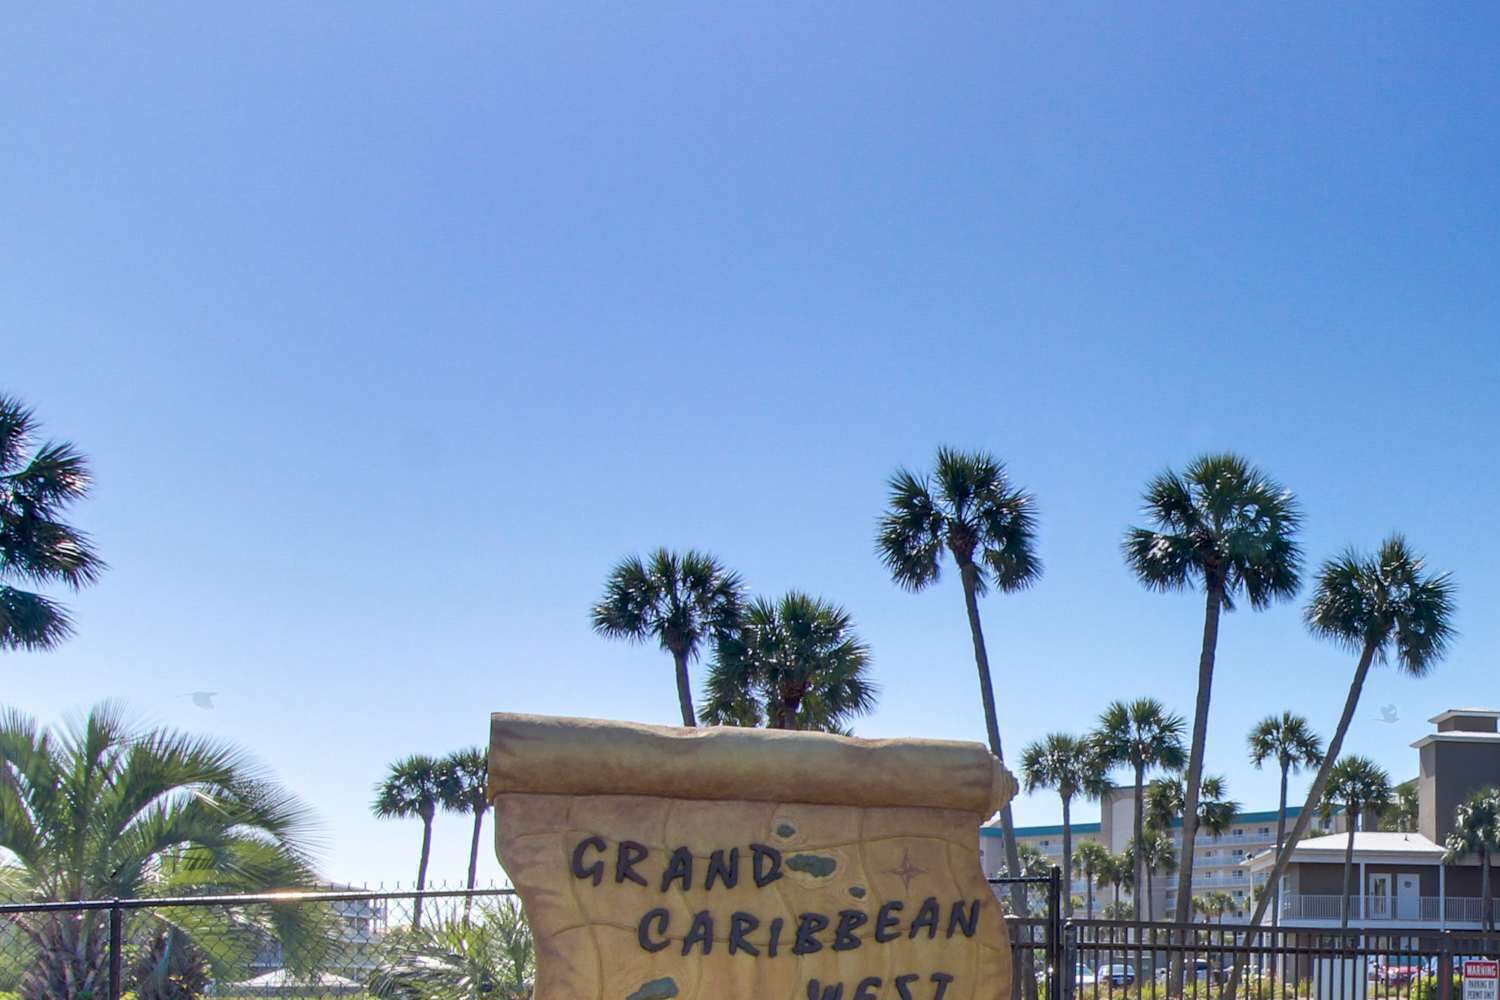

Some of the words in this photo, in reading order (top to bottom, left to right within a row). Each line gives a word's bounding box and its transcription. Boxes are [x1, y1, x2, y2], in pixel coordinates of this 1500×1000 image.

[572, 836, 784, 893] GRAND
[637, 898, 981, 957] CARIBBEAN
[1466, 964, 1496, 977] WARNING
[1468, 980, 1487, 989] PARKING
[1467, 991, 1482, 1000] PERMIT
[1483, 991, 1495, 1000] ONLY
